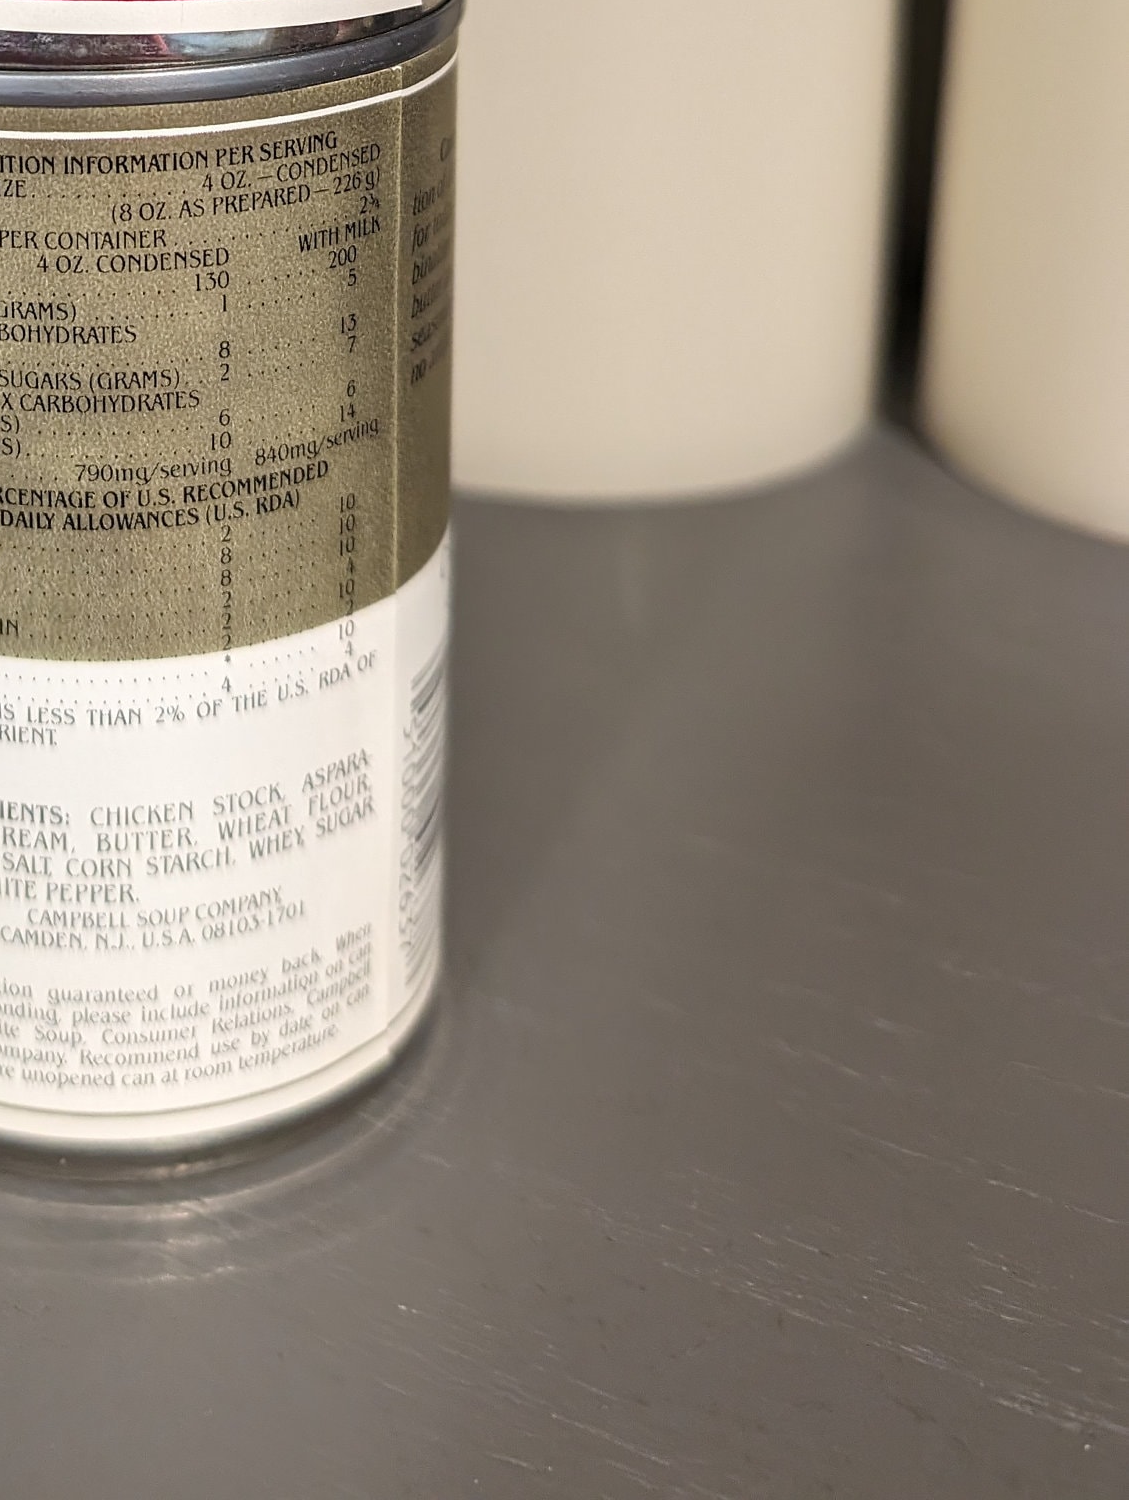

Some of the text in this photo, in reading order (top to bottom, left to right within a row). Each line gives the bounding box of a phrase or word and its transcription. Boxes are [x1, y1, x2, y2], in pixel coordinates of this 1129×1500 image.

[63, 151, 208, 175] INFORMATION
[215, 146, 254, 168] PER
[259, 131, 338, 163] SERVING
[202, 174, 212, 192] 4
[221, 169, 252, 191] OZ.
[37, 216, 382, 274] 4 OZ. CONDENSED WITH MILK
[43, 229, 167, 251] CONTAINER
[193, 272, 230, 291] 130
[328, 246, 358, 270] 200
[74, 418, 379, 485] 790mg/serving 840mg/serving
[102, 489, 131, 508] OF
[137, 486, 176, 507] U.S.
[183, 460, 329, 504] RECOMMENDED
[0, 508, 200, 531] DAILY ALLOWANCES
[89, 801, 194, 827] CHICKEN
[66, 857, 132, 878] CORN
[28, 887, 282, 929] CAMPBELL SOUP COMPANY
[46, 881, 140, 903] PEPPER.
[47, 968, 268, 1005] guaranteed or money
